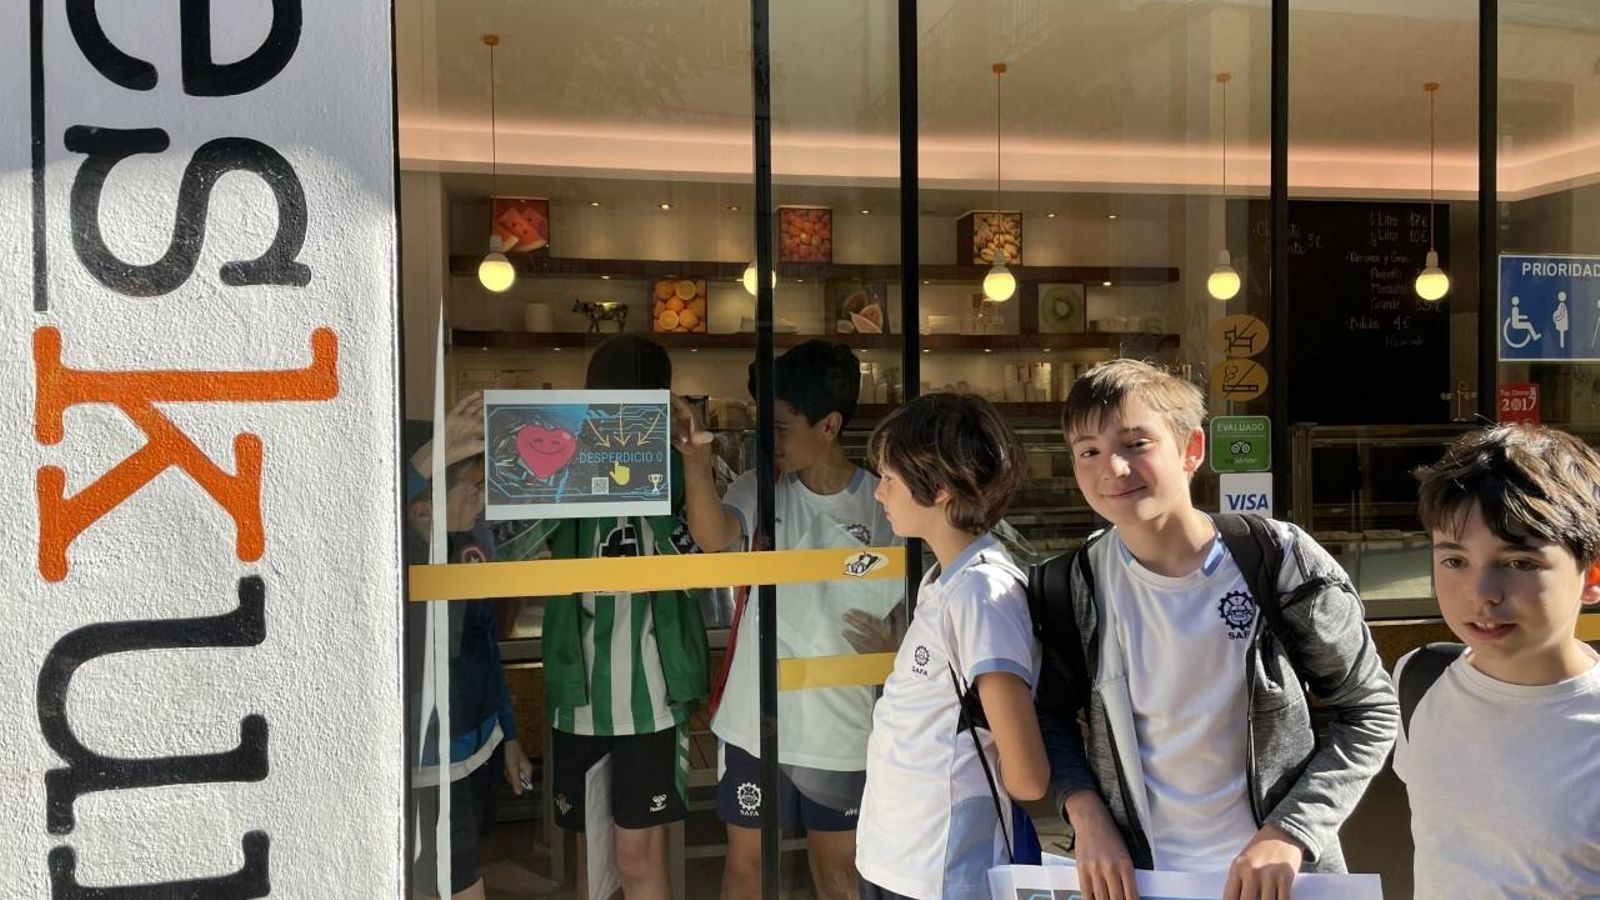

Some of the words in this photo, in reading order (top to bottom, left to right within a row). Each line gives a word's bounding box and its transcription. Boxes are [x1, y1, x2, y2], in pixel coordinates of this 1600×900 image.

[1521, 262, 1600, 277] PRIORIDAD
[1216, 422, 1265, 432] EVALUADO
[579, 451, 653, 464] DESPERDICIO
[1224, 493, 1270, 511] VISA
